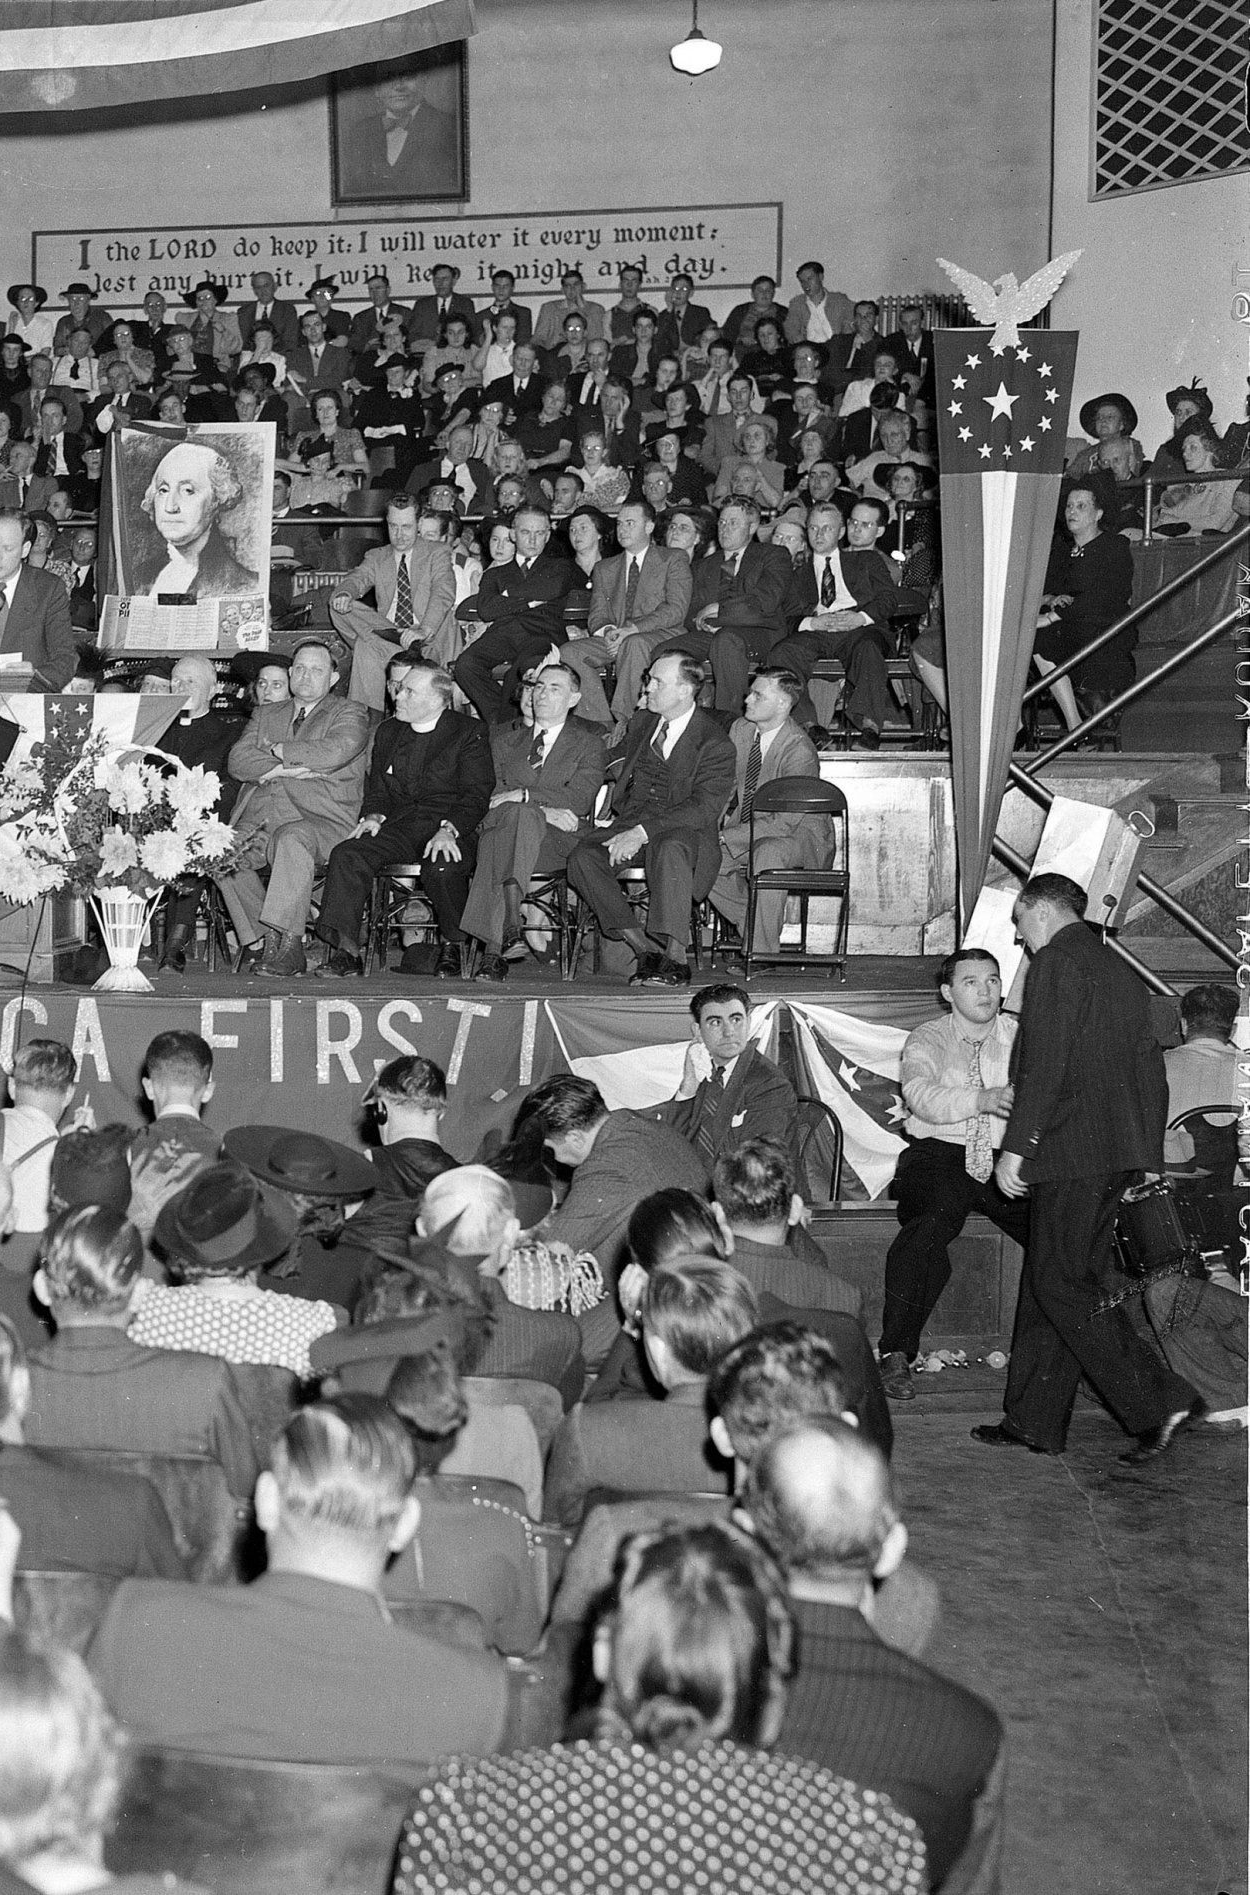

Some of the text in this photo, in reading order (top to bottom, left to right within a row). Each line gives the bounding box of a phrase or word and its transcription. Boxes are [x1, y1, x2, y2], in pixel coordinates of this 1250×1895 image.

[78, 239, 91, 271] I
[106, 242, 140, 262] the
[148, 238, 217, 261] LORD
[233, 236, 261, 257] do
[270, 235, 318, 259] keep
[358, 231, 369, 253] I
[380, 230, 425, 252] will
[434, 229, 501, 250] water
[513, 226, 529, 247] it
[540, 228, 602, 251] every
[613, 222, 718, 243] moment:
[94, 272, 136, 293] lest
[148, 274, 191, 298] any
[339, 264, 387, 285] will
[478, 260, 496, 280] it
[513, 258, 584, 285] night
[598, 254, 648, 276] and
[664, 253, 727, 280] day.
